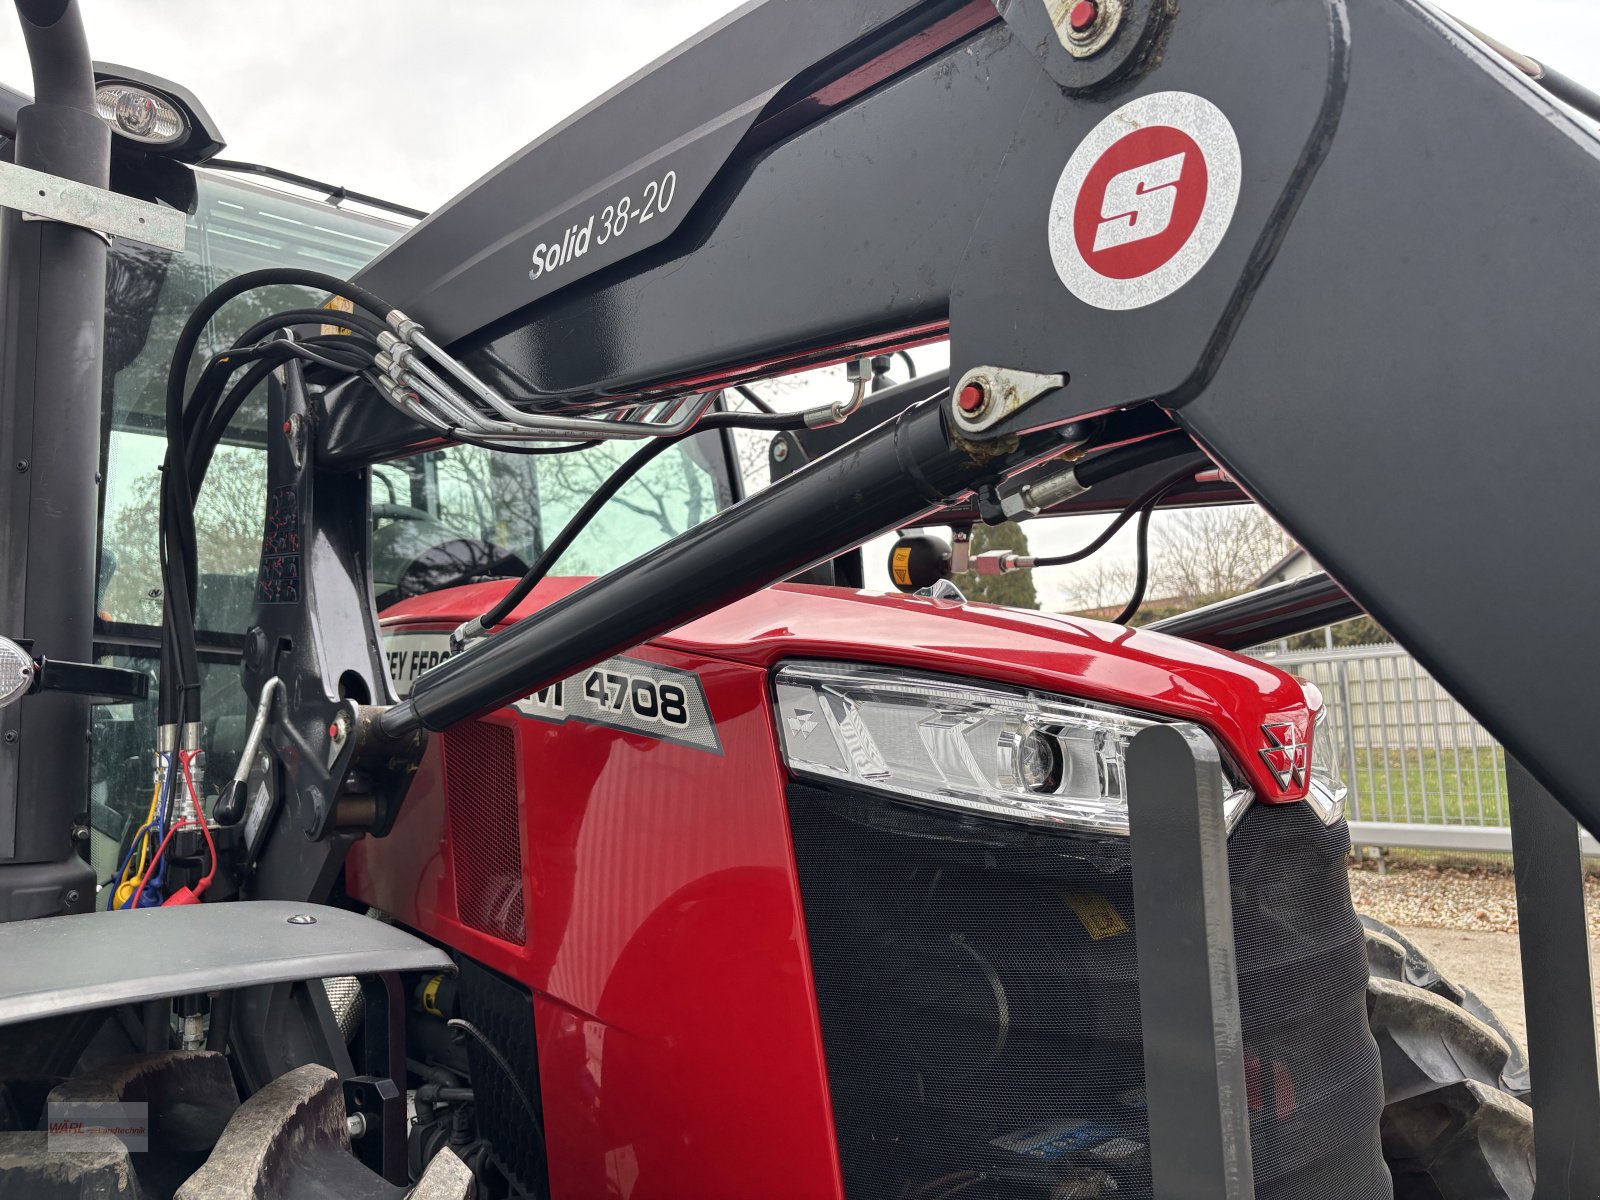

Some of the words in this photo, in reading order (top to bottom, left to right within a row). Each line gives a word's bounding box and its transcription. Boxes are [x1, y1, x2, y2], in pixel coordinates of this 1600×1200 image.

[529, 215, 594, 281] Solid
[597, 170, 676, 245] 38-20
[584, 669, 689, 727] 4708
